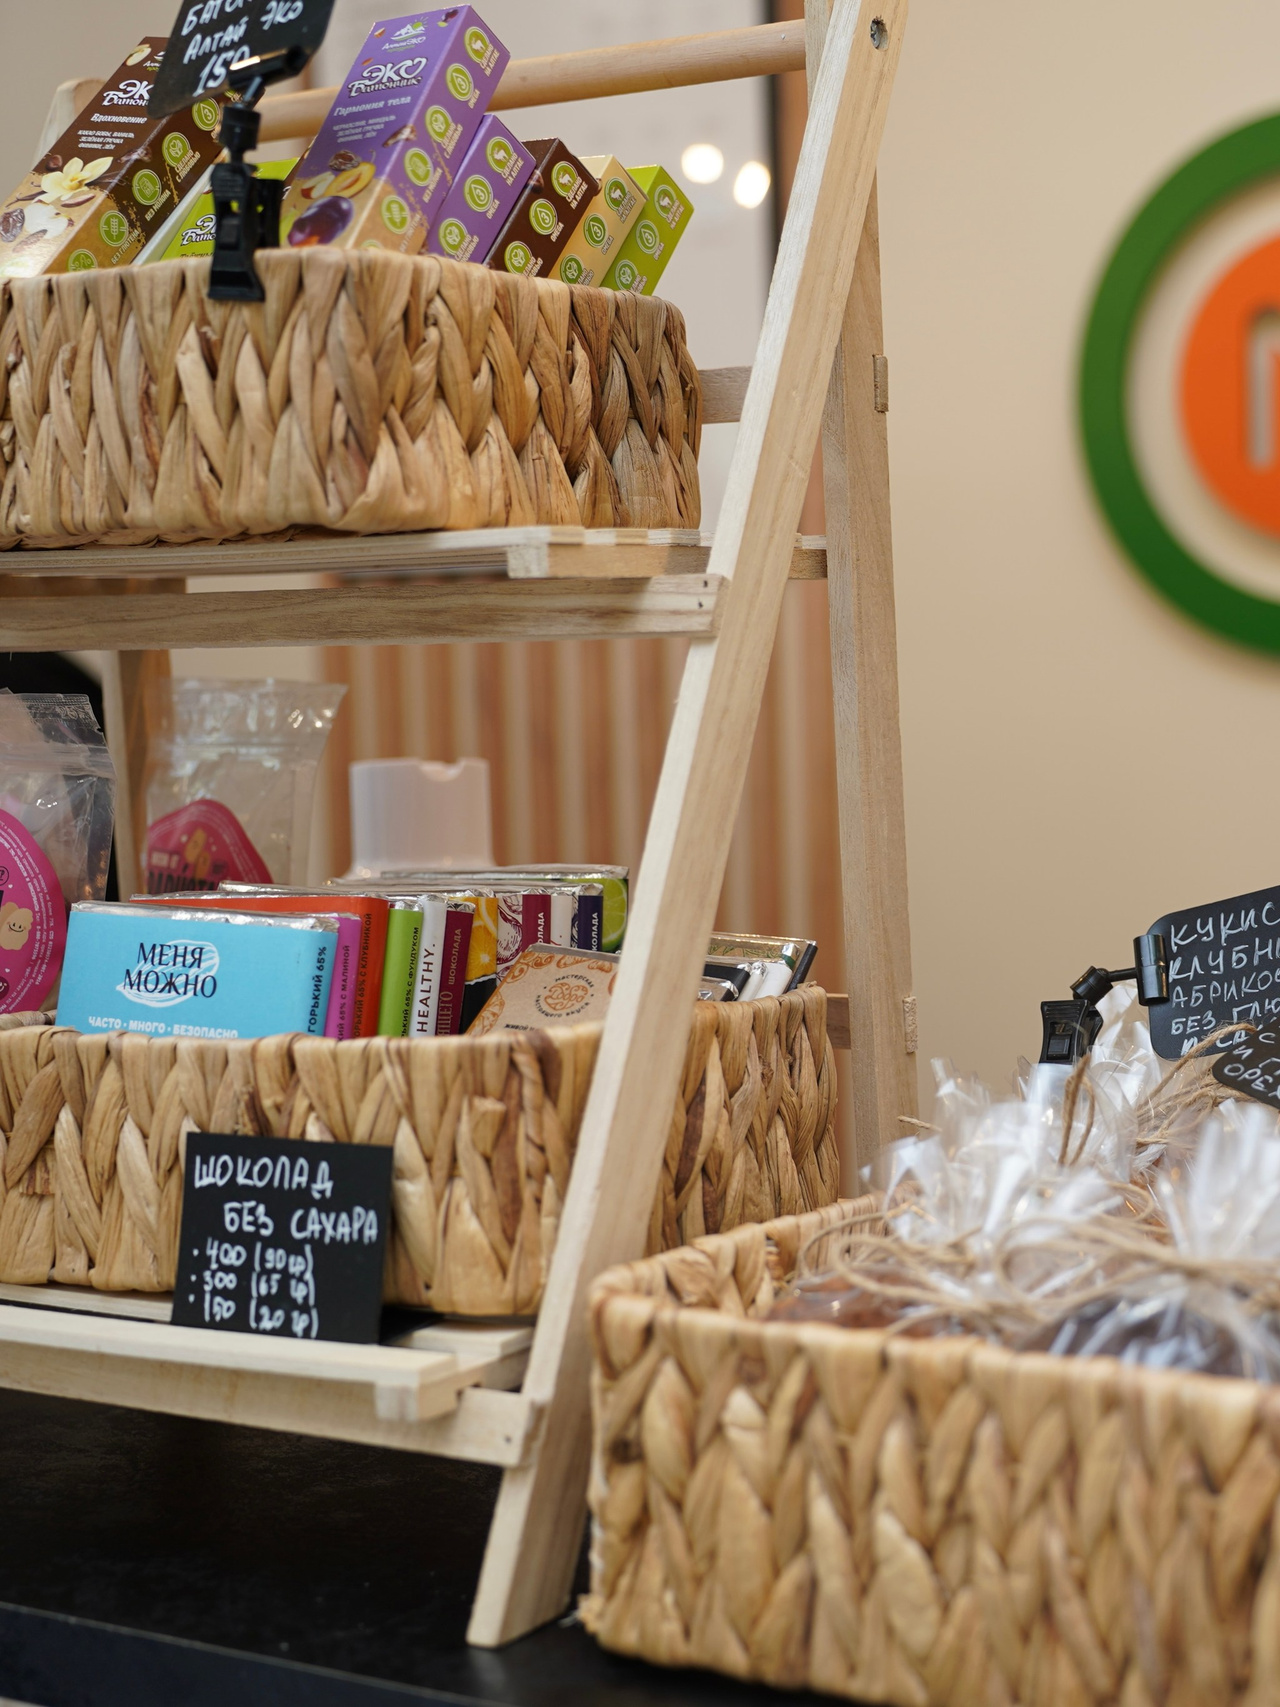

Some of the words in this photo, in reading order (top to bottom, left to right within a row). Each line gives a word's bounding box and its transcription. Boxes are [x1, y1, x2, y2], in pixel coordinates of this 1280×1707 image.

[181, 0, 245, 36] БАТО
[260, 0, 303, 30] ЭКО
[183, 16, 249, 64] АЛТАЙ
[362, 57, 428, 83] ЭКО
[102, 91, 149, 106] Батон
[119, 80, 154, 99] ЭК
[90, 113, 147, 124] Вдохновение
[334, 101, 384, 116] Гармония
[387, 96, 411, 107] тела
[137, 942, 205, 969] МЕНЯ
[361, 913, 372, 969] КЛУБНИКОЙ
[408, 927, 419, 978] ФУНДУКОМ
[342, 945, 350, 992] МАЛИНОЙ
[448, 928, 462, 985] ШОКОЛАДА
[123, 969, 217, 998] МОЖНО
[308, 975, 323, 1033] ГОРЬКИЙ
[316, 946, 327, 972] 65%
[358, 979, 366, 997] 65%
[417, 943, 435, 1032] HEALTHY.
[88, 1016, 121, 1029] ЧАСТО
[129, 1020, 166, 1033] МНОГО
[173, 1024, 238, 1039] БЕЗОПАСНО
[354, 999, 363, 1038] ОРЬКИЙ
[1171, 1010, 1217, 1036] БЕЗ
[1233, 1045, 1253, 1060] И
[1258, 1032, 1276, 1044] С
[194, 1154, 334, 1200] ШОКОЛАД
[223, 1200, 274, 1237] БЕЗ
[290, 1206, 378, 1245] САХАРА
[206, 1237, 247, 1270] 400
[203, 1271, 237, 1292] 300
[204, 1291, 236, 1323] 150
